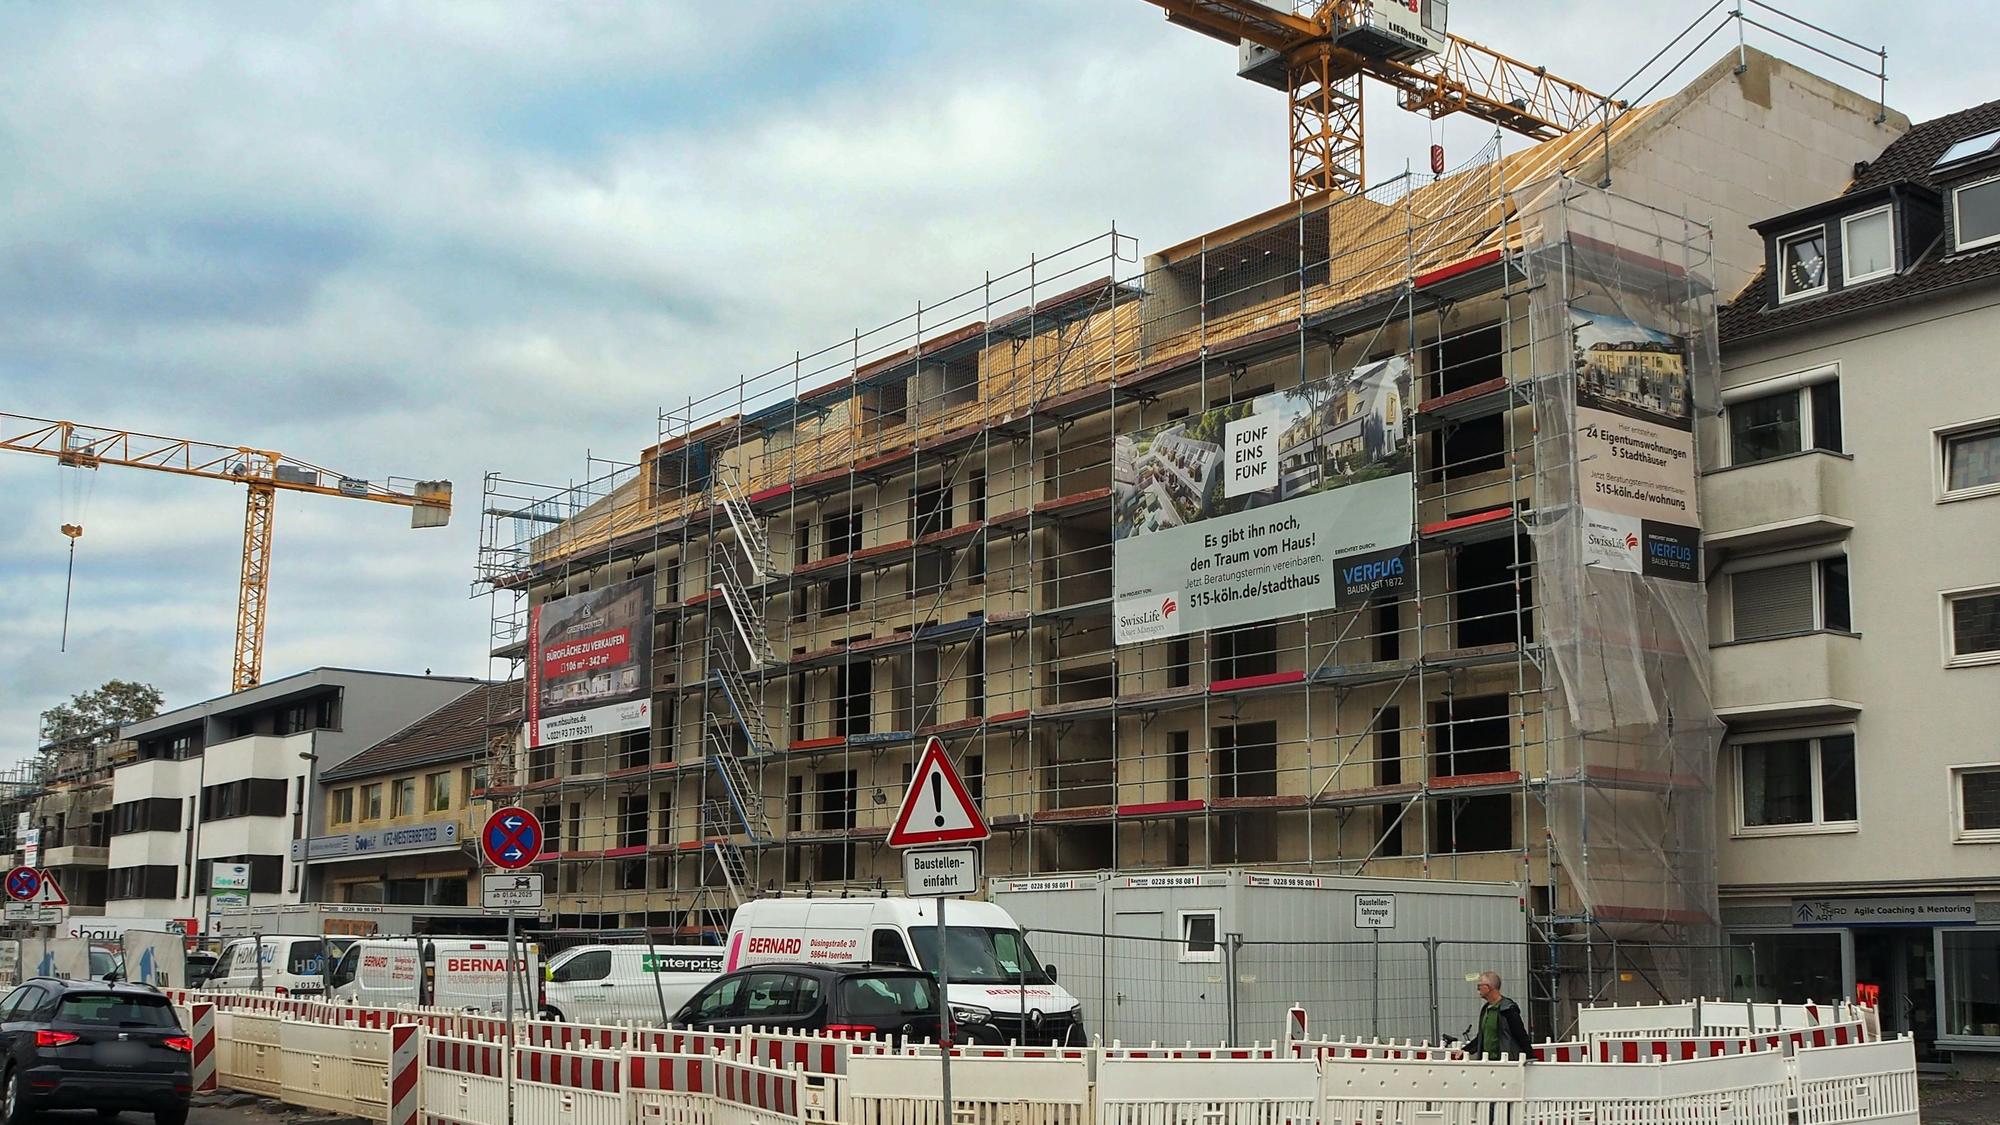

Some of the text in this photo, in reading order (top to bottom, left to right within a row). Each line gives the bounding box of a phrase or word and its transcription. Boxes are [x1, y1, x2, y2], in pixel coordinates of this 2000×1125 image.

[1388, 21, 1428, 46] LIEBHERR
[1236, 426, 1268, 446] FÜNF
[1586, 428, 1687, 459] 24 Eigentumswohnungen
[1236, 445, 1263, 463] EINS
[1612, 446, 1667, 467] 5 Stadthäuser
[1235, 461, 1268, 480] FÜNF
[1595, 481, 1686, 510] 515-köln.de/wohnung
[1204, 514, 1300, 548] Es gibt ihn noch,
[1190, 532, 1316, 572] den Traum vom Haus!
[1184, 554, 1324, 590] Jetzt Beratungstermin vereinbaren.
[1190, 573, 1320, 608] 515-köln.de/stadthaus
[1347, 583, 1370, 596] BAUEN
[1385, 577, 1404, 587] 1872
[1120, 609, 1160, 628] SwissLife
[546, 634, 625, 662] BÜROFLÄCHE ZU VERKAUFEN
[589, 655, 601, 667] 342
[914, 856, 965, 870] Baustellen-
[923, 874, 958, 887] einfahrt
[1359, 898, 1391, 906] Baustellen-
[1854, 907, 1875, 916] Agile
[1877, 905, 1915, 915] Coaching
[1926, 905, 1971, 914] Mentoring
[1361, 907, 1388, 917] fahrzeuge
[1368, 917, 1381, 925] frei
[749, 938, 802, 954] BERNARD
[810, 939, 857, 949] Düsingstraße 30
[828, 951, 853, 960] Iserlohn
